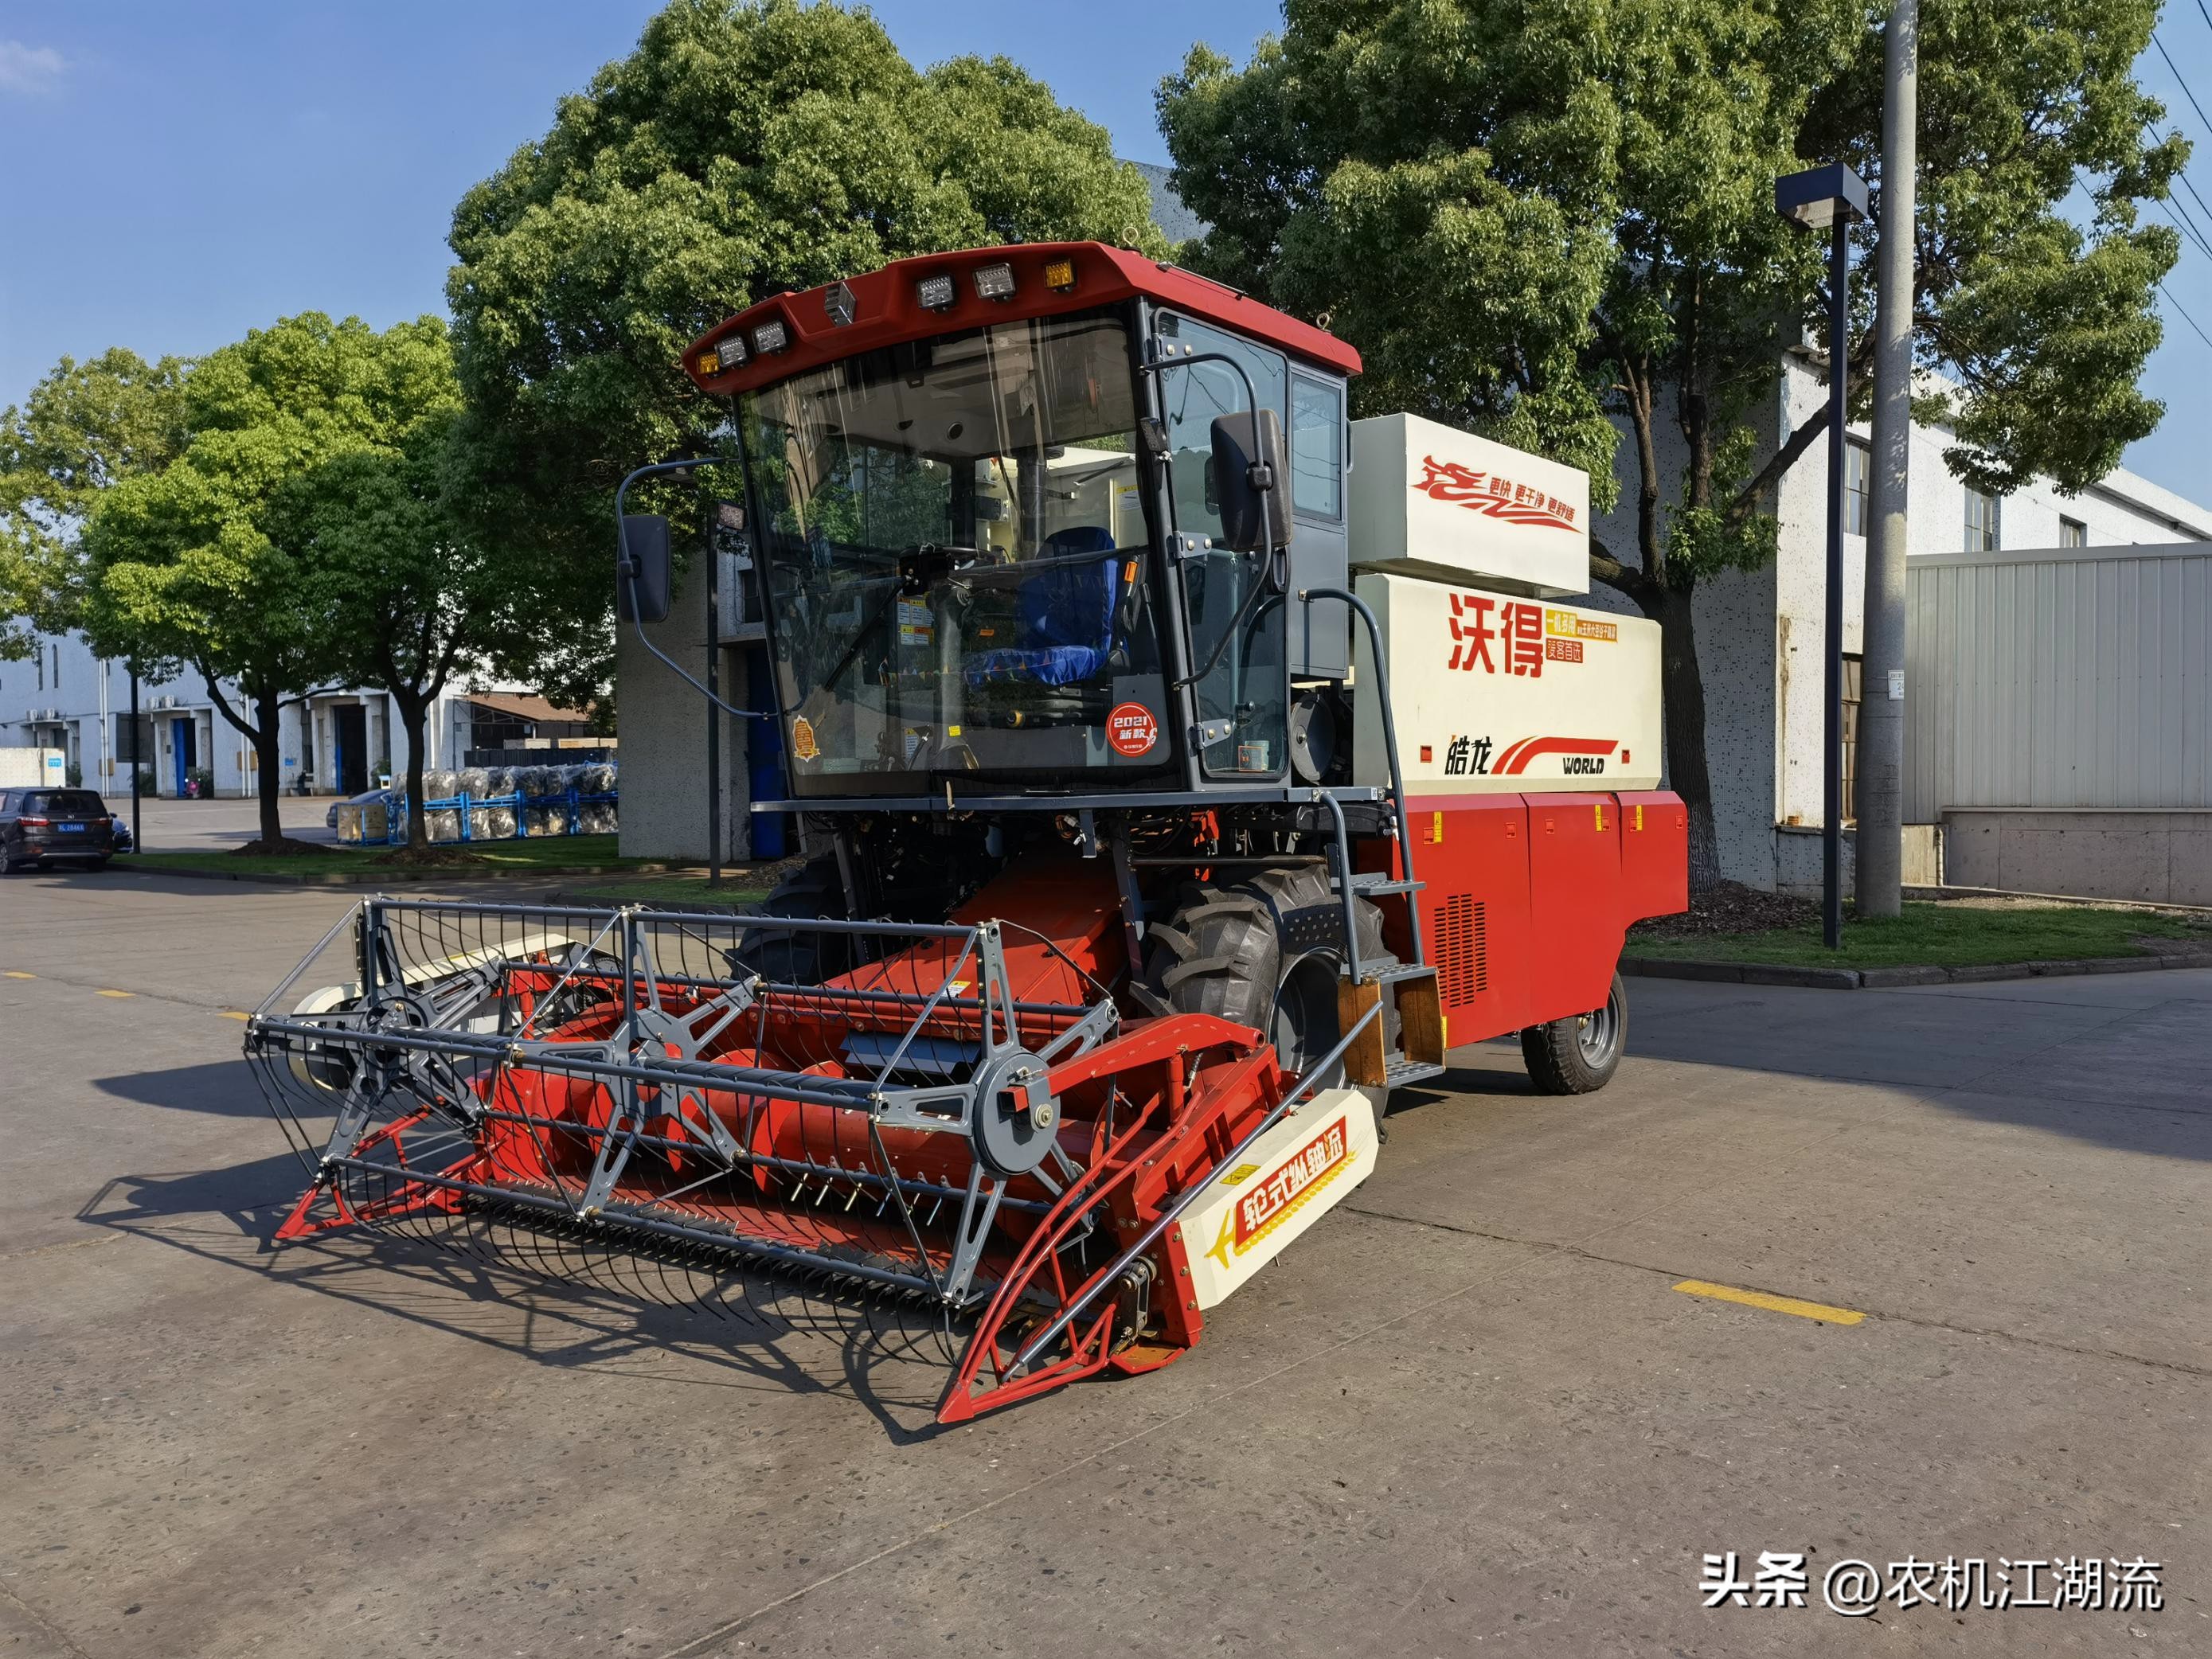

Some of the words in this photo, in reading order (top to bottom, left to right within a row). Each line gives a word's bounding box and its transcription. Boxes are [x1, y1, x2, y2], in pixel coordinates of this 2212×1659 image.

[1489, 477, 1511, 498] 更快
[1514, 484, 1546, 508] 更干净
[1547, 497, 1576, 522] 更舒适
[1448, 593, 1543, 677] 沃得
[1114, 716, 1147, 728] 2021
[1120, 728, 1147, 740] 新款
[1444, 735, 1492, 775] 皓龙
[1562, 757, 1604, 775] WORLD
[1242, 1125, 1344, 1232] 轮式纵轴流
